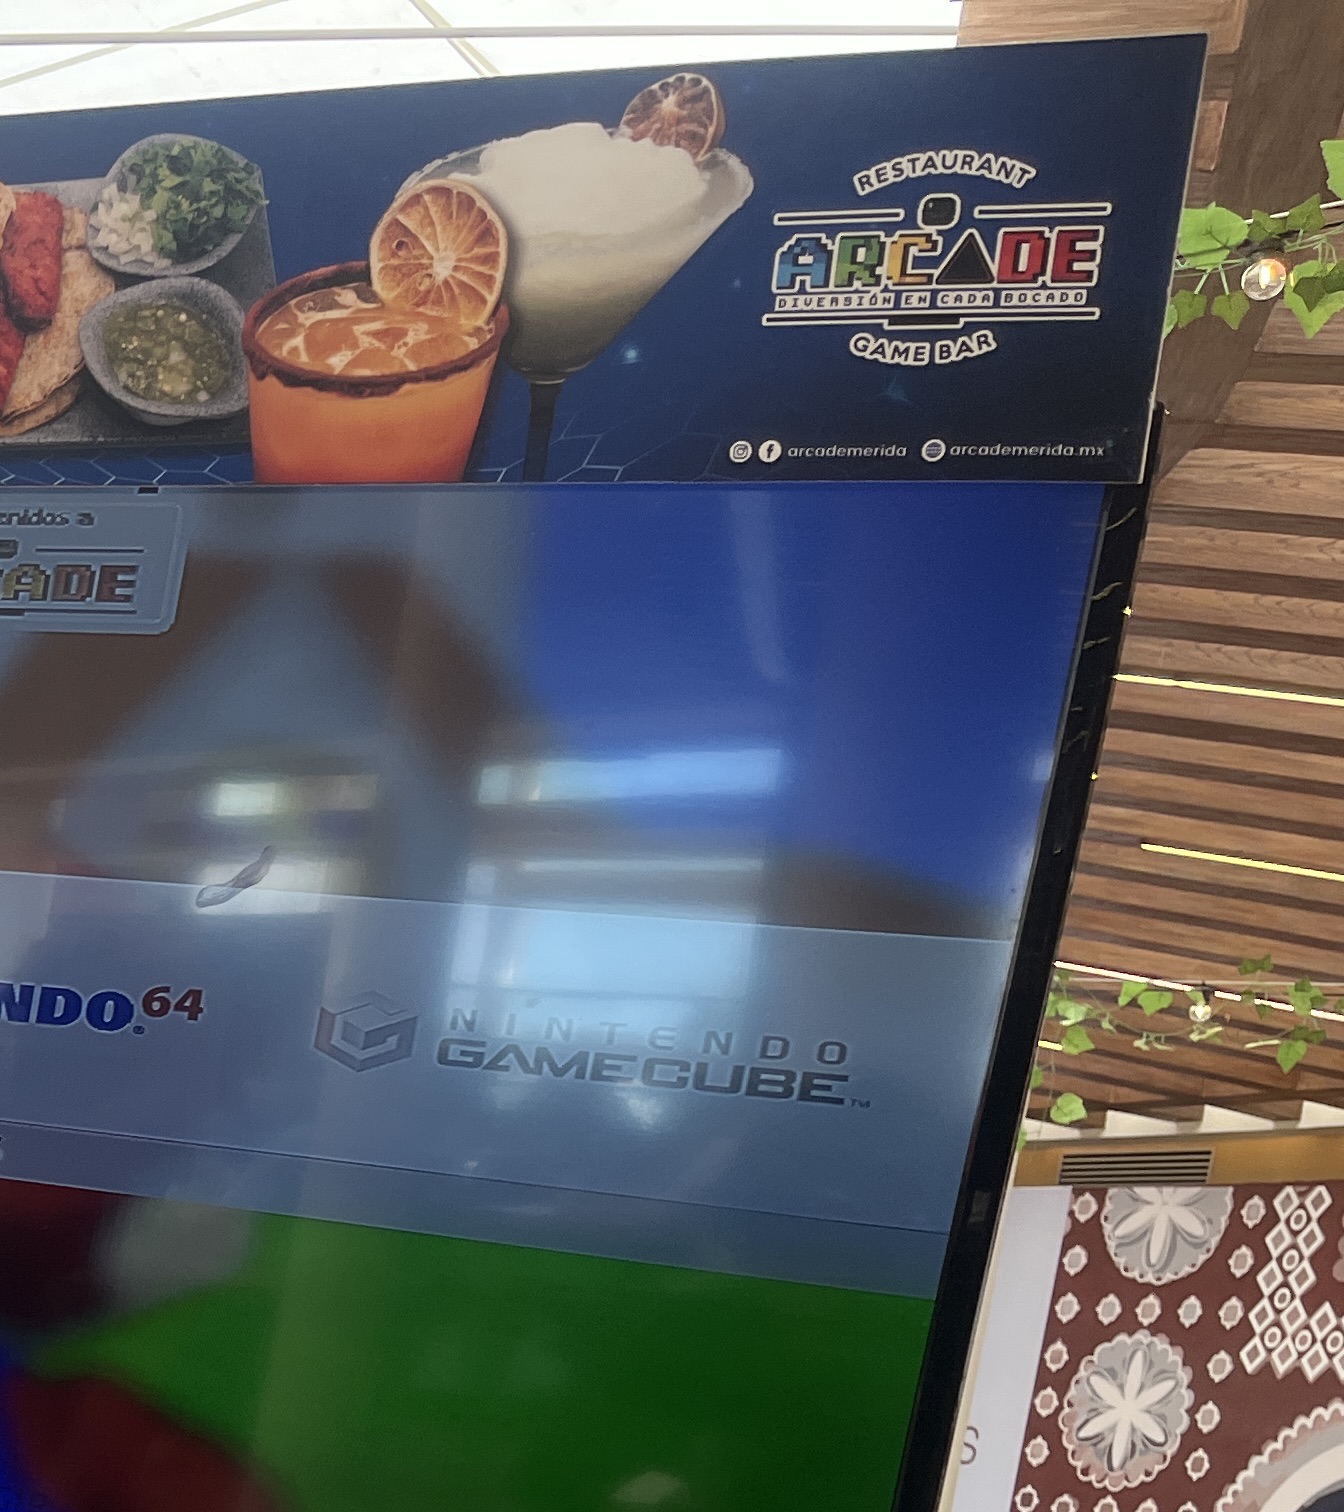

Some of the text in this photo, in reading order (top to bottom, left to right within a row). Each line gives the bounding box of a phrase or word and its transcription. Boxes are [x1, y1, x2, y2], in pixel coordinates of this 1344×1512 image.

[855, 151, 1034, 194] RESTAURANT
[903, 293, 930, 307] EN
[939, 291, 993, 306] CADA
[1002, 290, 1085, 305] BOCADO
[852, 331, 996, 364] GAME BAR
[787, 442, 1105, 459] arcademerida arcademerida.mx
[76, 511, 94, 527] a
[141, 985, 206, 1023] 64
[449, 1006, 849, 1066] NINTENDO
[435, 1036, 851, 1107] GAMECUBE
